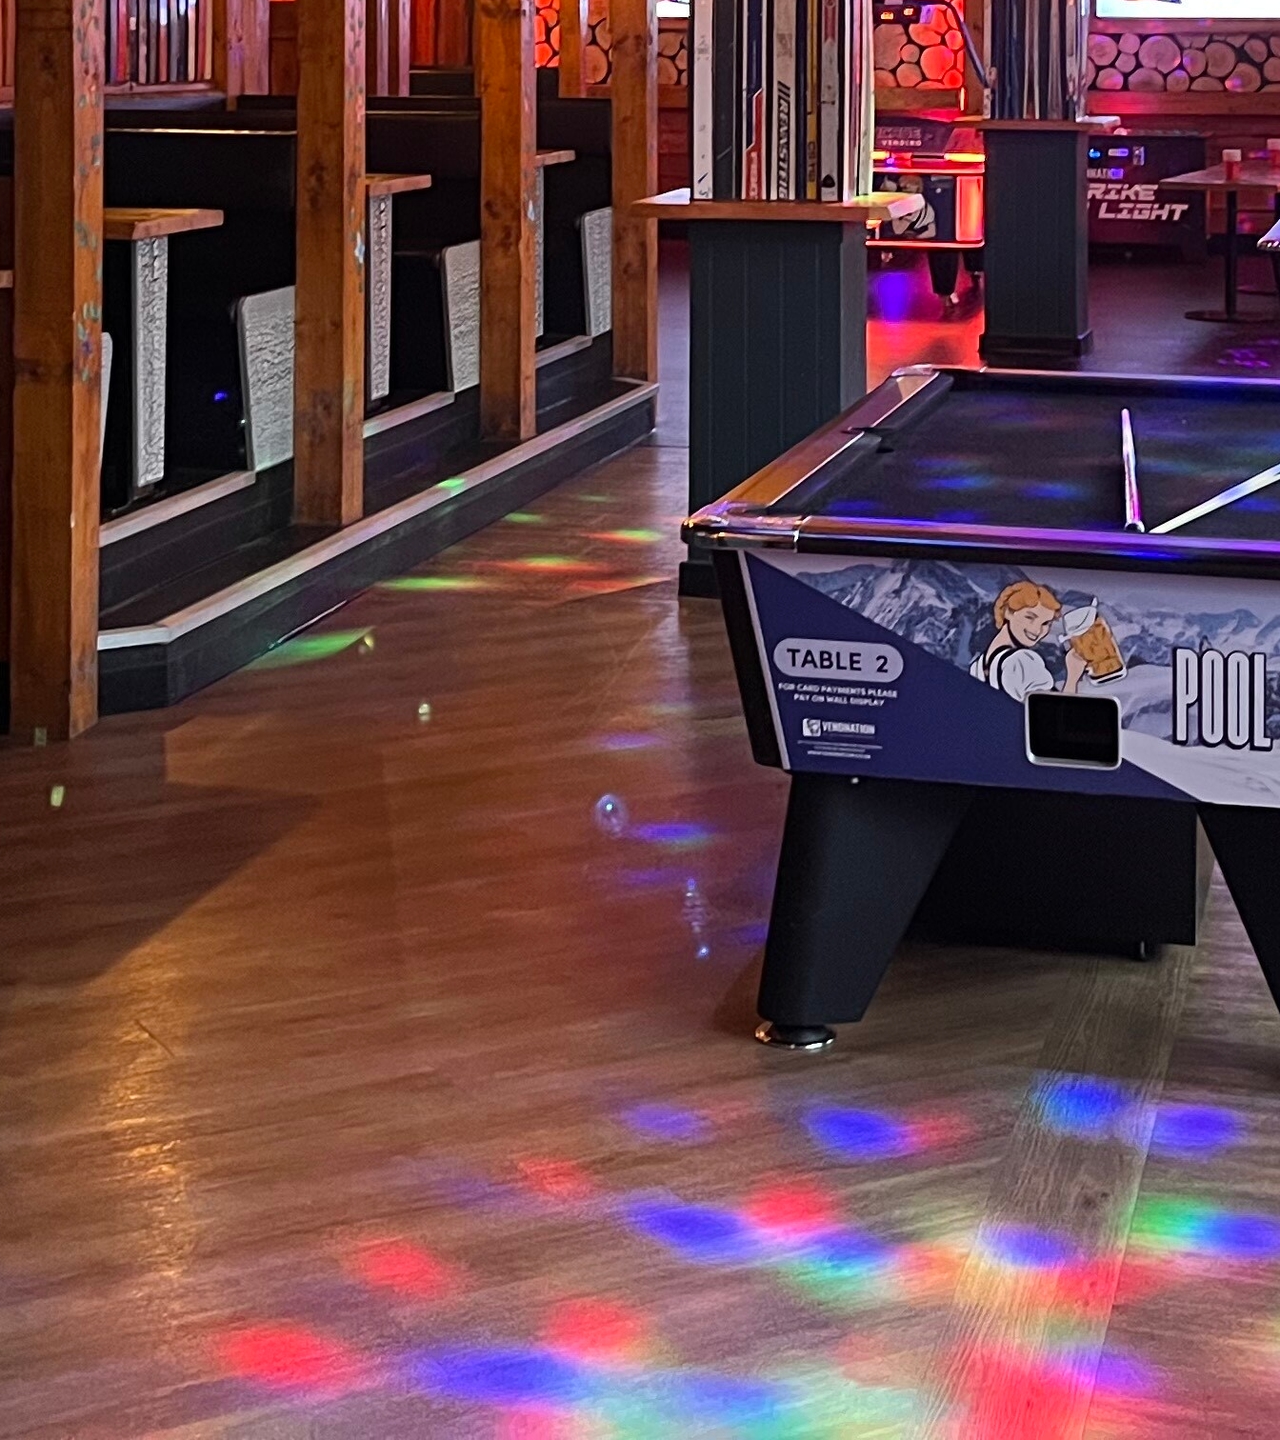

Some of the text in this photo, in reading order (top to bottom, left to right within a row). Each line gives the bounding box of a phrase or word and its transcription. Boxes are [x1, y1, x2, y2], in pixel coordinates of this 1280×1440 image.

[1098, 202, 1189, 221] LIGHT
[787, 648, 889, 673] TABLE 2
[778, 682, 898, 698] FOR CARD PAYMENTS PLEASE
[1173, 647, 1272, 751] POOL
[793, 693, 885, 707] PAY ON WALL DISPLAY
